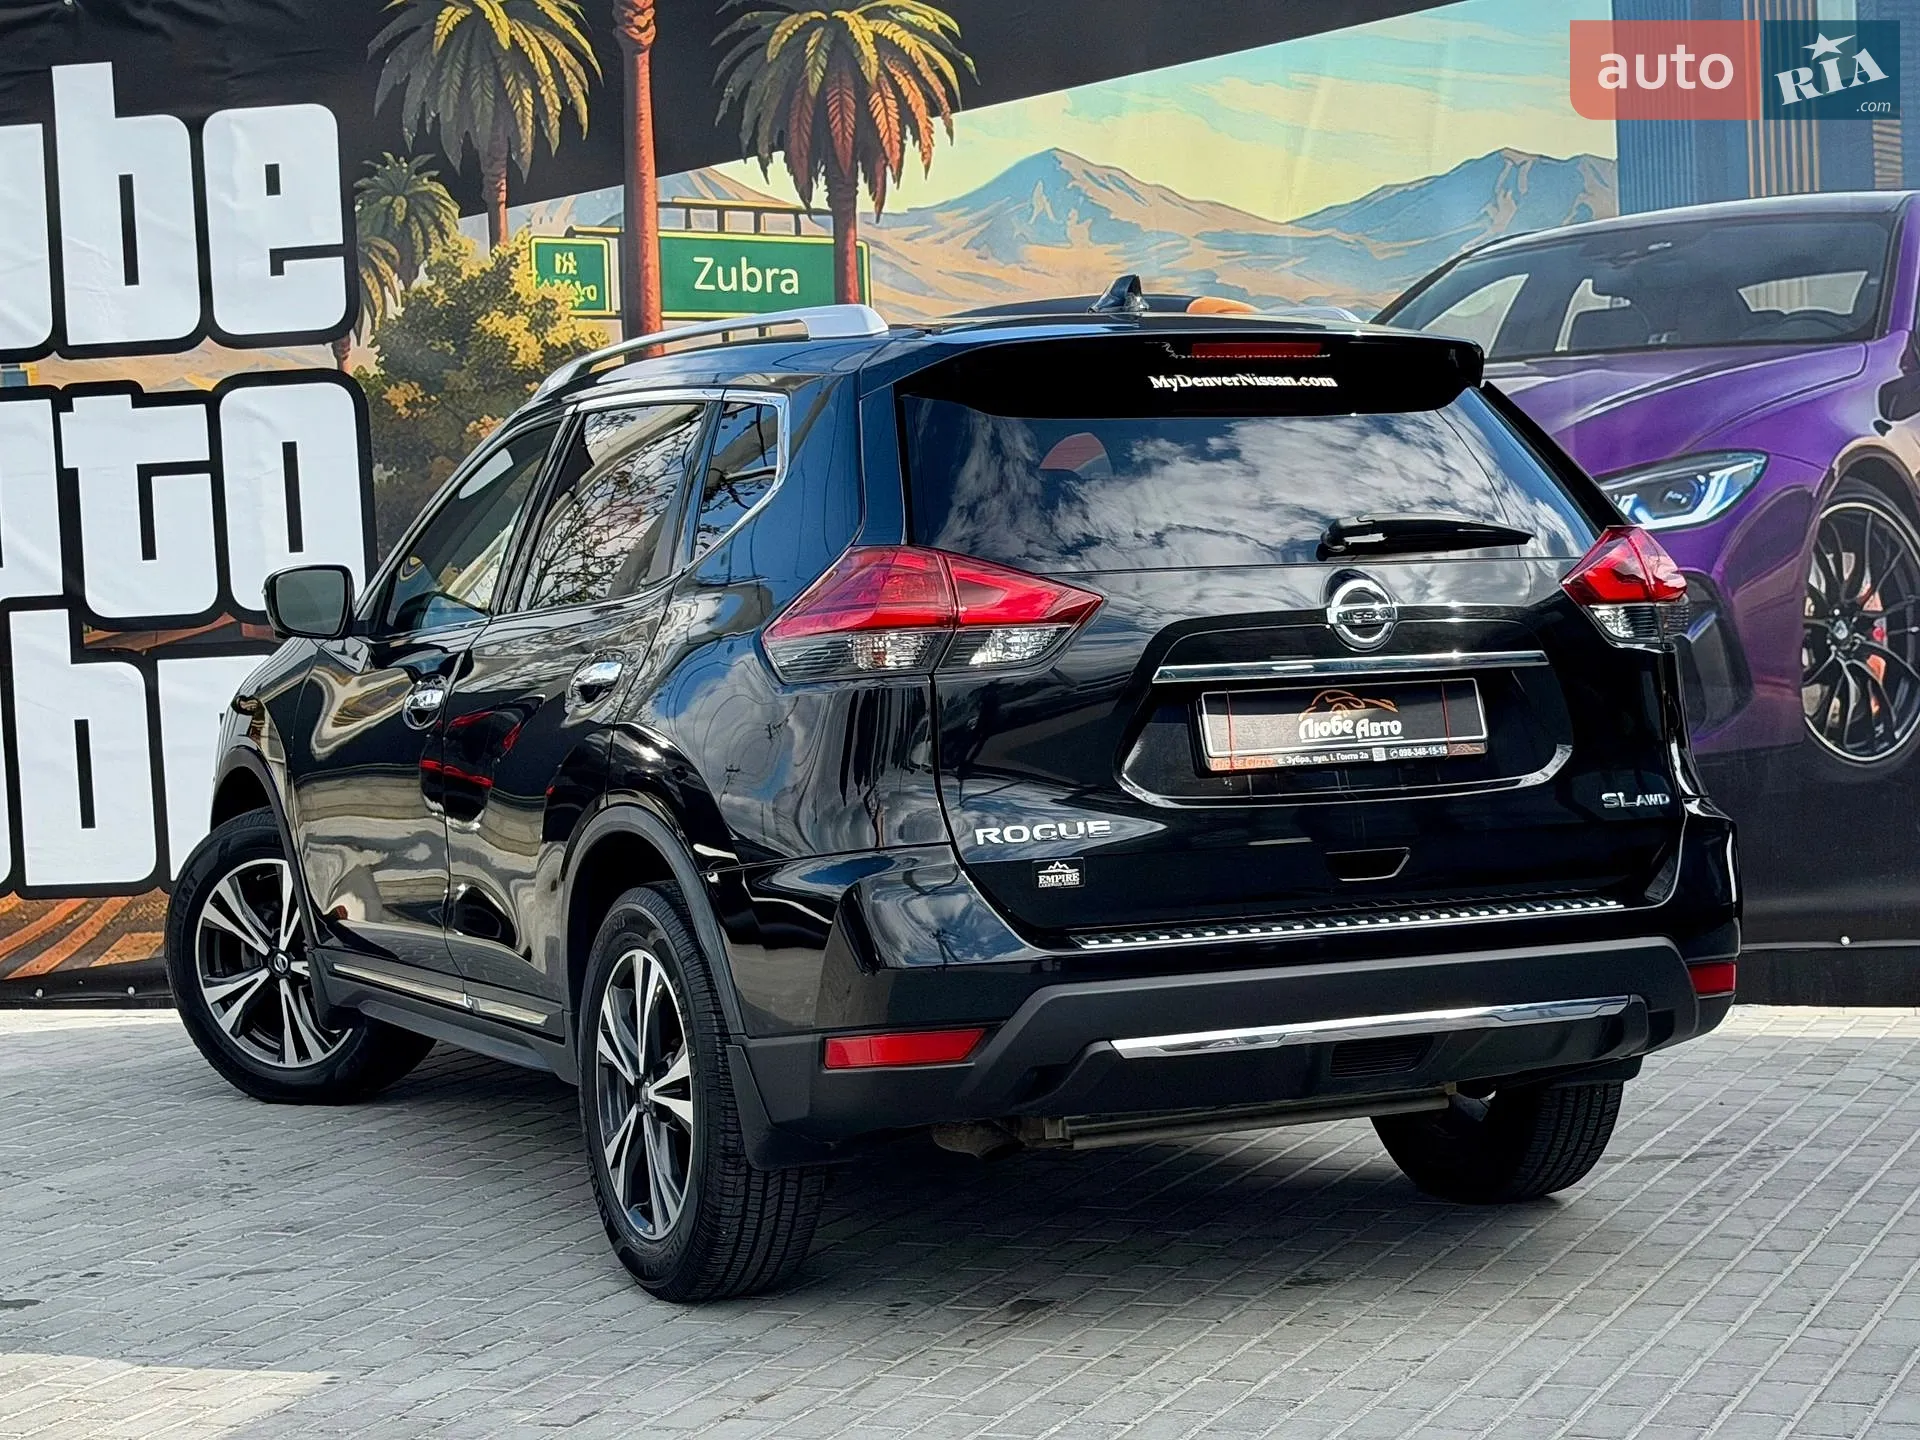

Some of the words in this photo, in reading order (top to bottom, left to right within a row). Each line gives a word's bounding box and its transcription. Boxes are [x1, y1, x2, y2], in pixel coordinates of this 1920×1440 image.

[693, 256, 799, 295] Zubra
[1148, 373, 1338, 392] MyDenverNissan.com
[1299, 715, 1354, 739] Любе
[1356, 718, 1402, 739] Авто
[1601, 791, 1637, 808] SL
[1636, 793, 1670, 807] AWD
[974, 820, 1112, 846] ROGUE
[1038, 872, 1080, 884] EMPIRE
